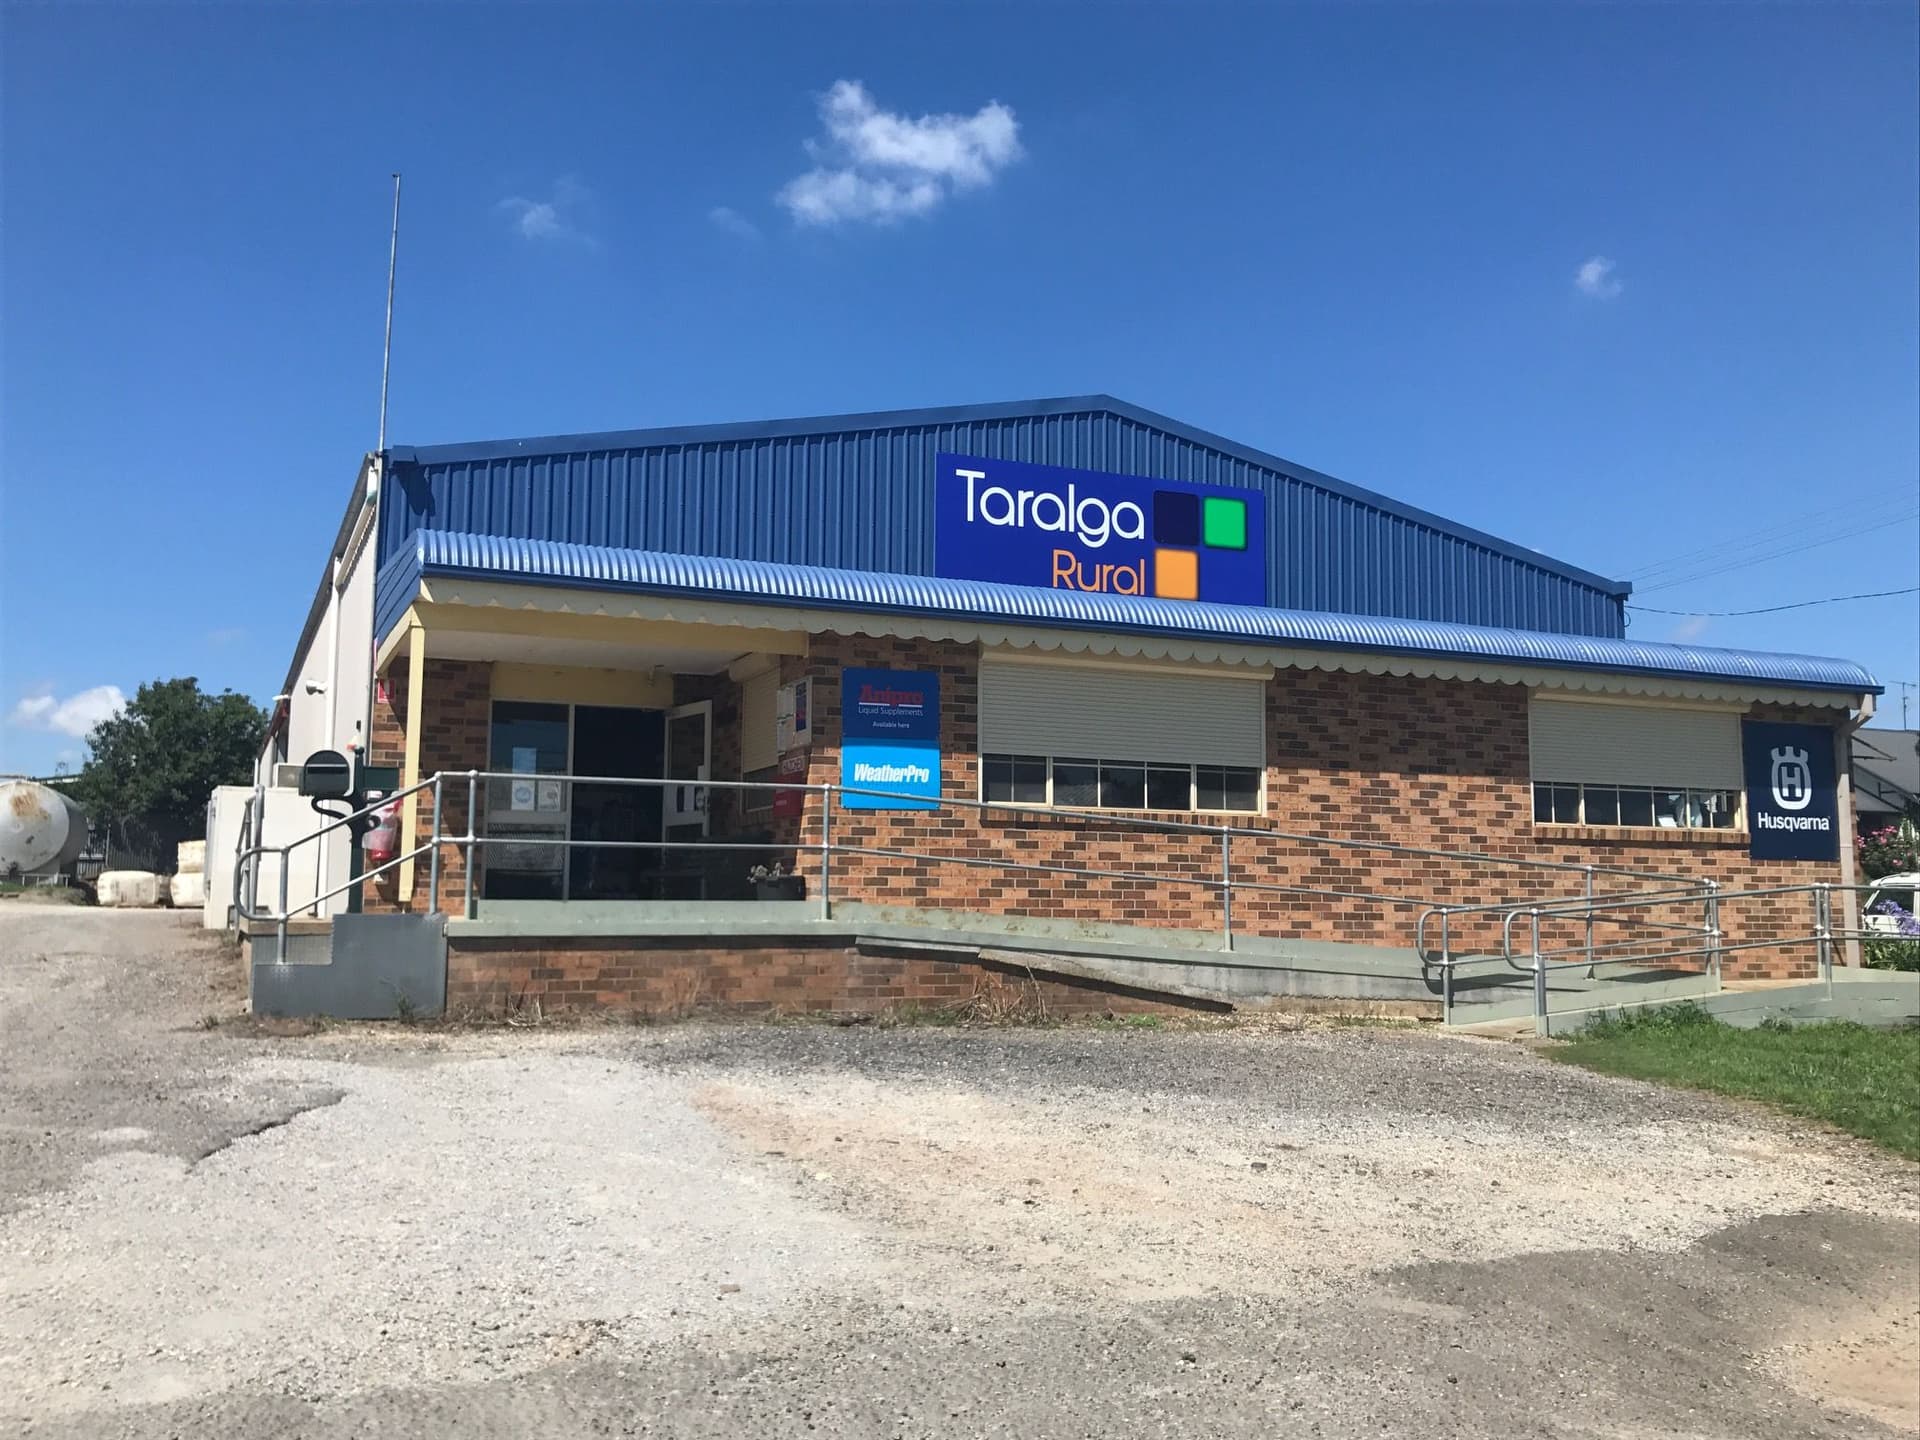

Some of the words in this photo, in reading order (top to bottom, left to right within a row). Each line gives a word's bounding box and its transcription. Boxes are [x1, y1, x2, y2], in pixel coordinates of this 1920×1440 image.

[955, 468, 1145, 548] Taralga
[1052, 549, 1145, 596] Rural
[858, 705, 878, 716] Liquid
[880, 707, 924, 717] Supplements
[898, 721, 910, 729] here
[854, 763, 930, 783] WeatherPro
[1758, 812, 1830, 832] Husqvarna
